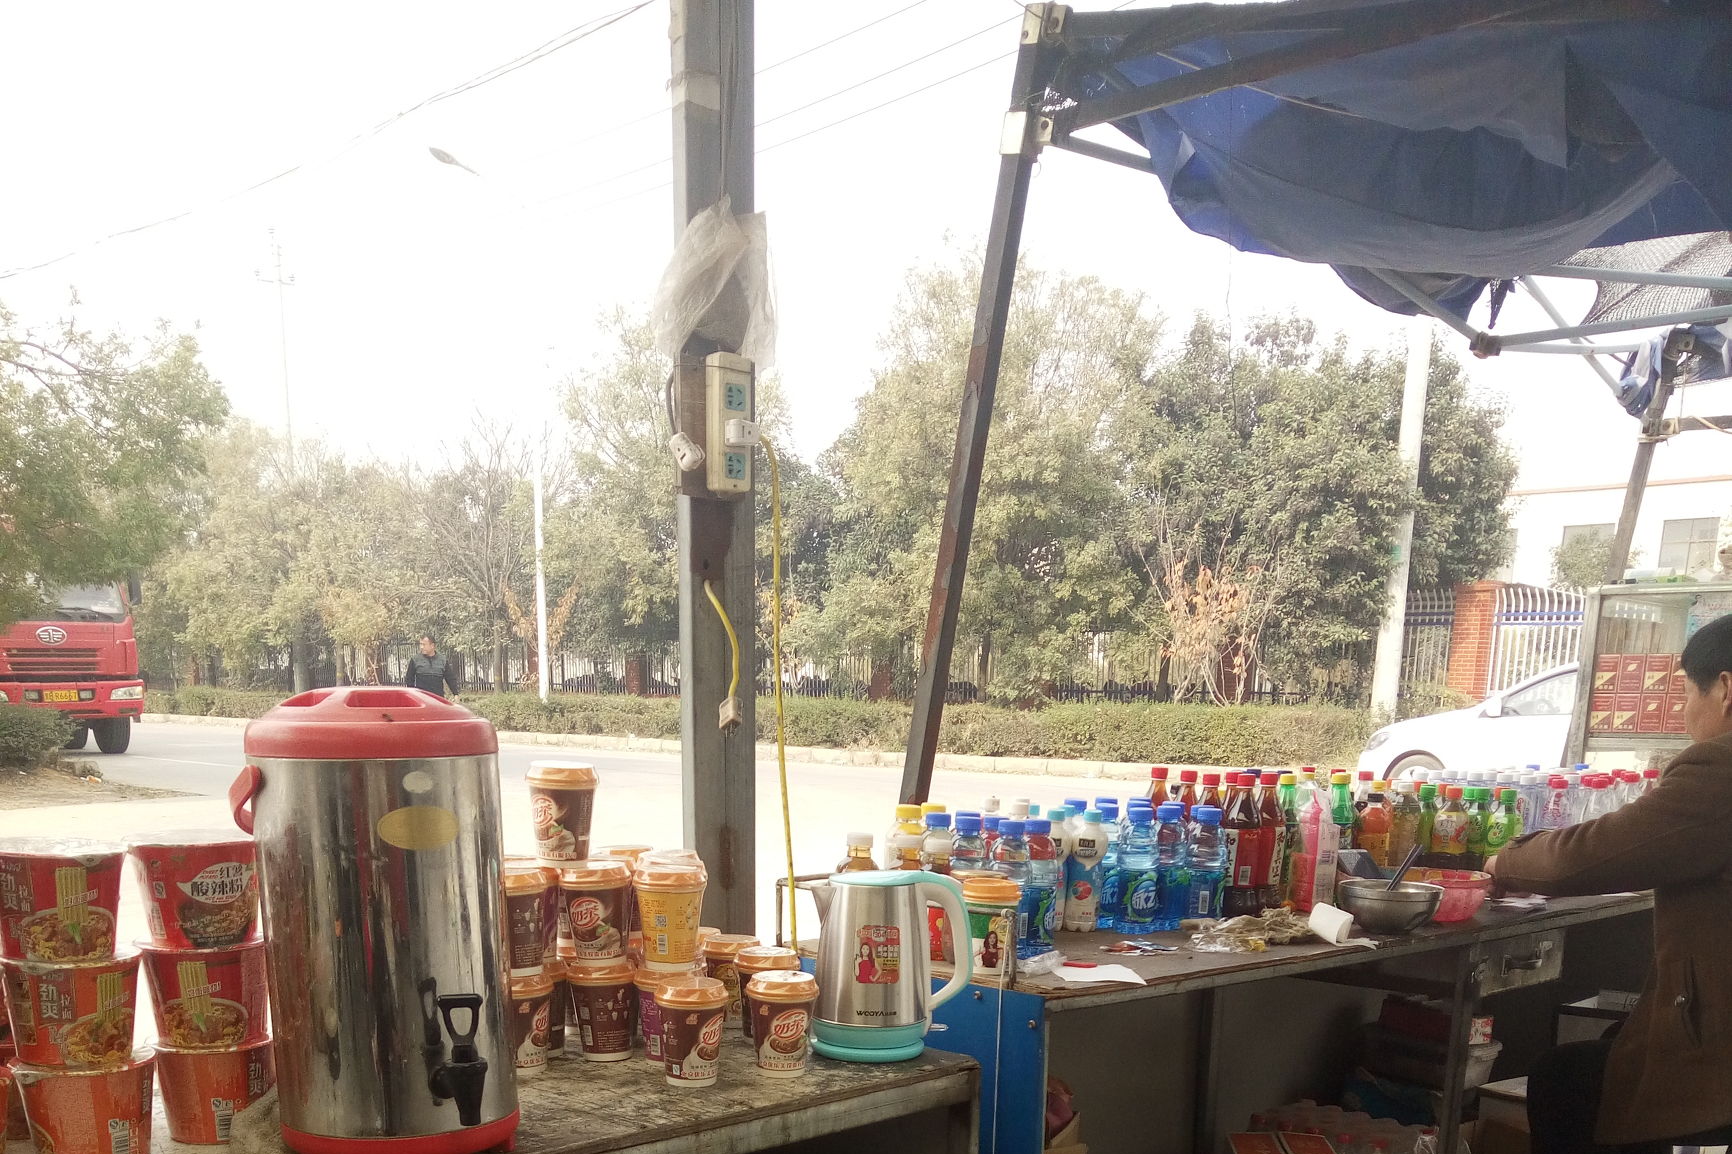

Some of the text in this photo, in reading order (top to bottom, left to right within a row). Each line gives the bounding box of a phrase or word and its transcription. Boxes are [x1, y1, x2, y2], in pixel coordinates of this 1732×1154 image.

[190, 879, 242, 897] 酸辣粉
[39, 983, 59, 1019] 劲爽
[773, 1017, 806, 1038] 奶茶
